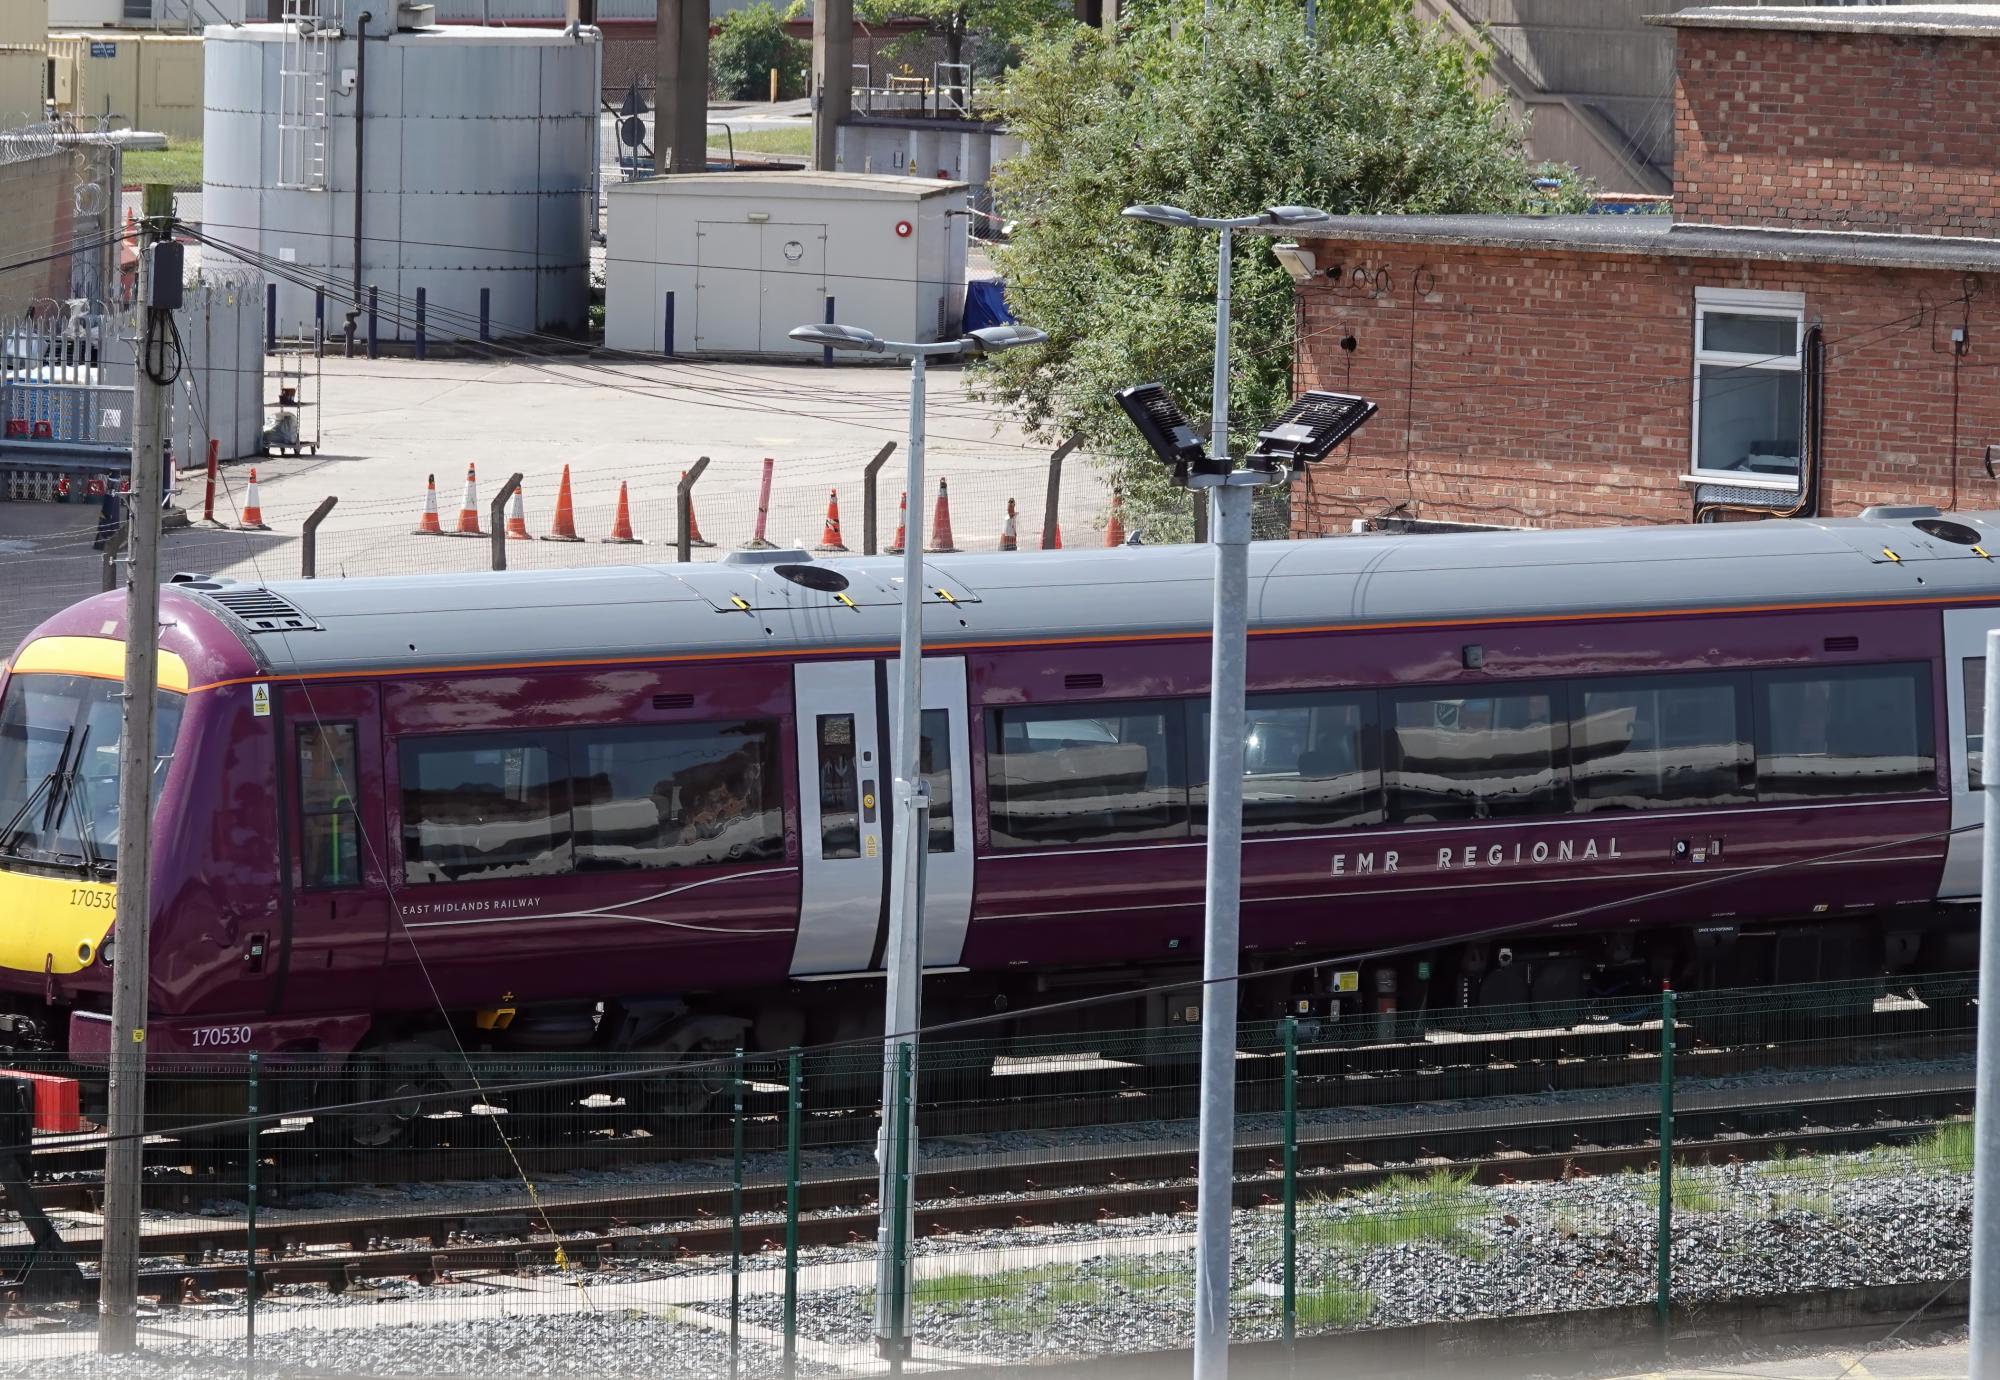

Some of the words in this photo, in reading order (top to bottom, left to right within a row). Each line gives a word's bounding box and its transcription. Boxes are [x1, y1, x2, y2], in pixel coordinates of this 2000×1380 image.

[1331, 850, 1399, 876] EMR
[1437, 837, 1622, 870] REGIONAL
[70, 889, 117, 909] 170530
[402, 904, 430, 915] EAST
[434, 901, 490, 913] MIDLANDS
[494, 897, 541, 909] RAILWAY
[192, 1026, 252, 1047] 170530
